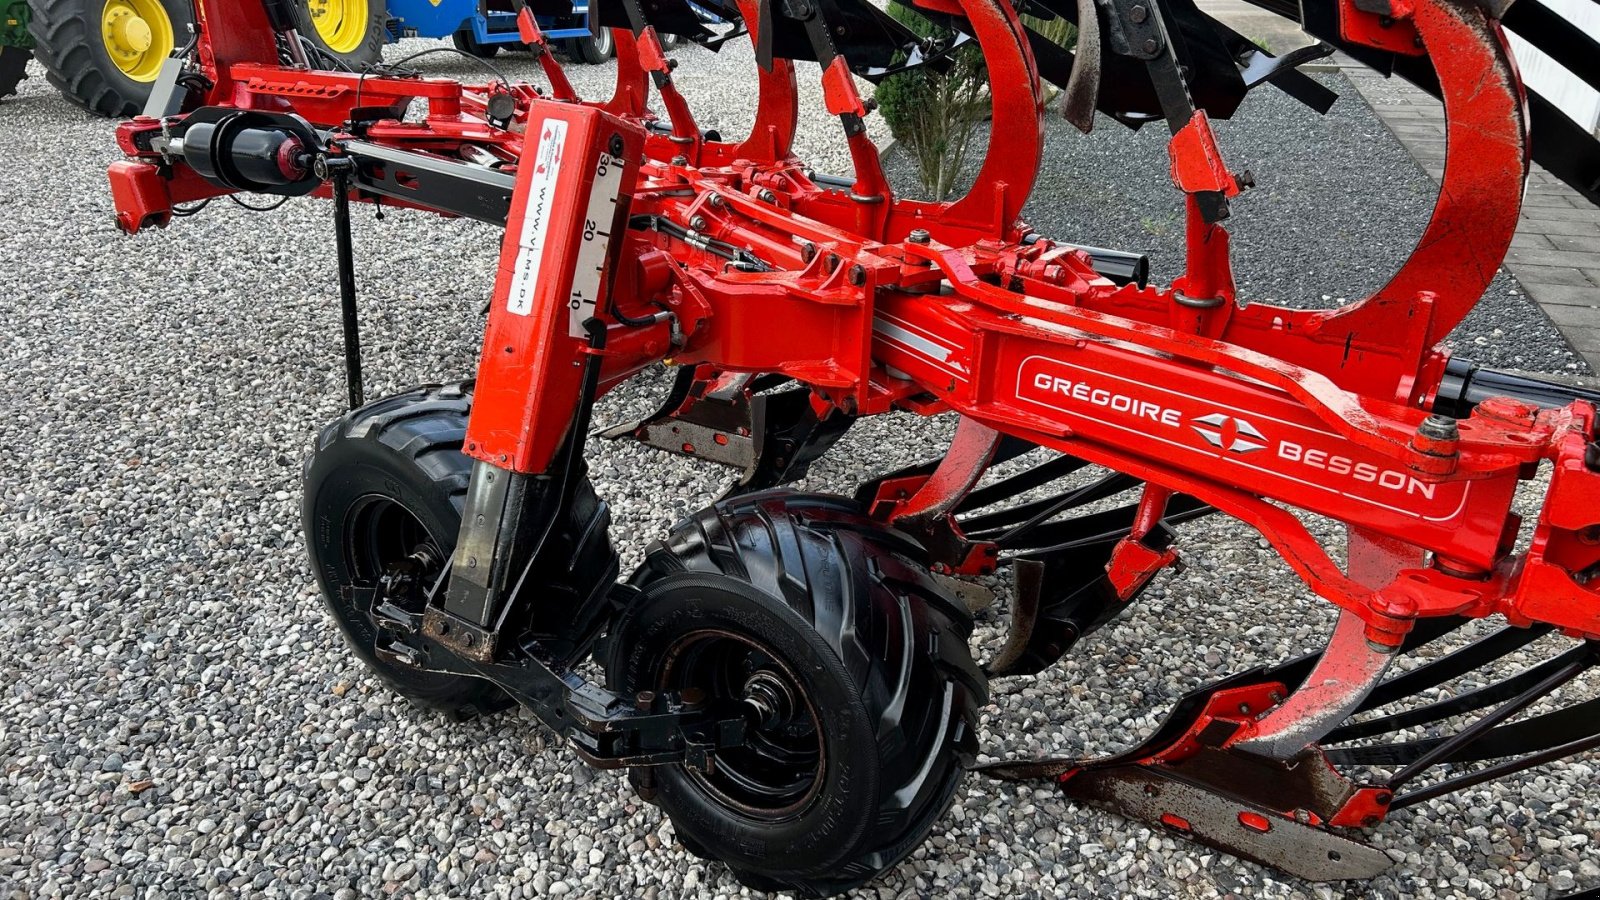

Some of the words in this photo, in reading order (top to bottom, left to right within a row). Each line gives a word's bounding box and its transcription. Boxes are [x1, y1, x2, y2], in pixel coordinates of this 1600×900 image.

[597, 154, 610, 178] 30
[583, 219, 597, 242] 20
[516, 186, 547, 309] WWW.VLMS.DK
[570, 290, 582, 311] 10
[1034, 373, 1182, 427] GRÉGOIRE
[1278, 440, 1436, 500] BESSON
